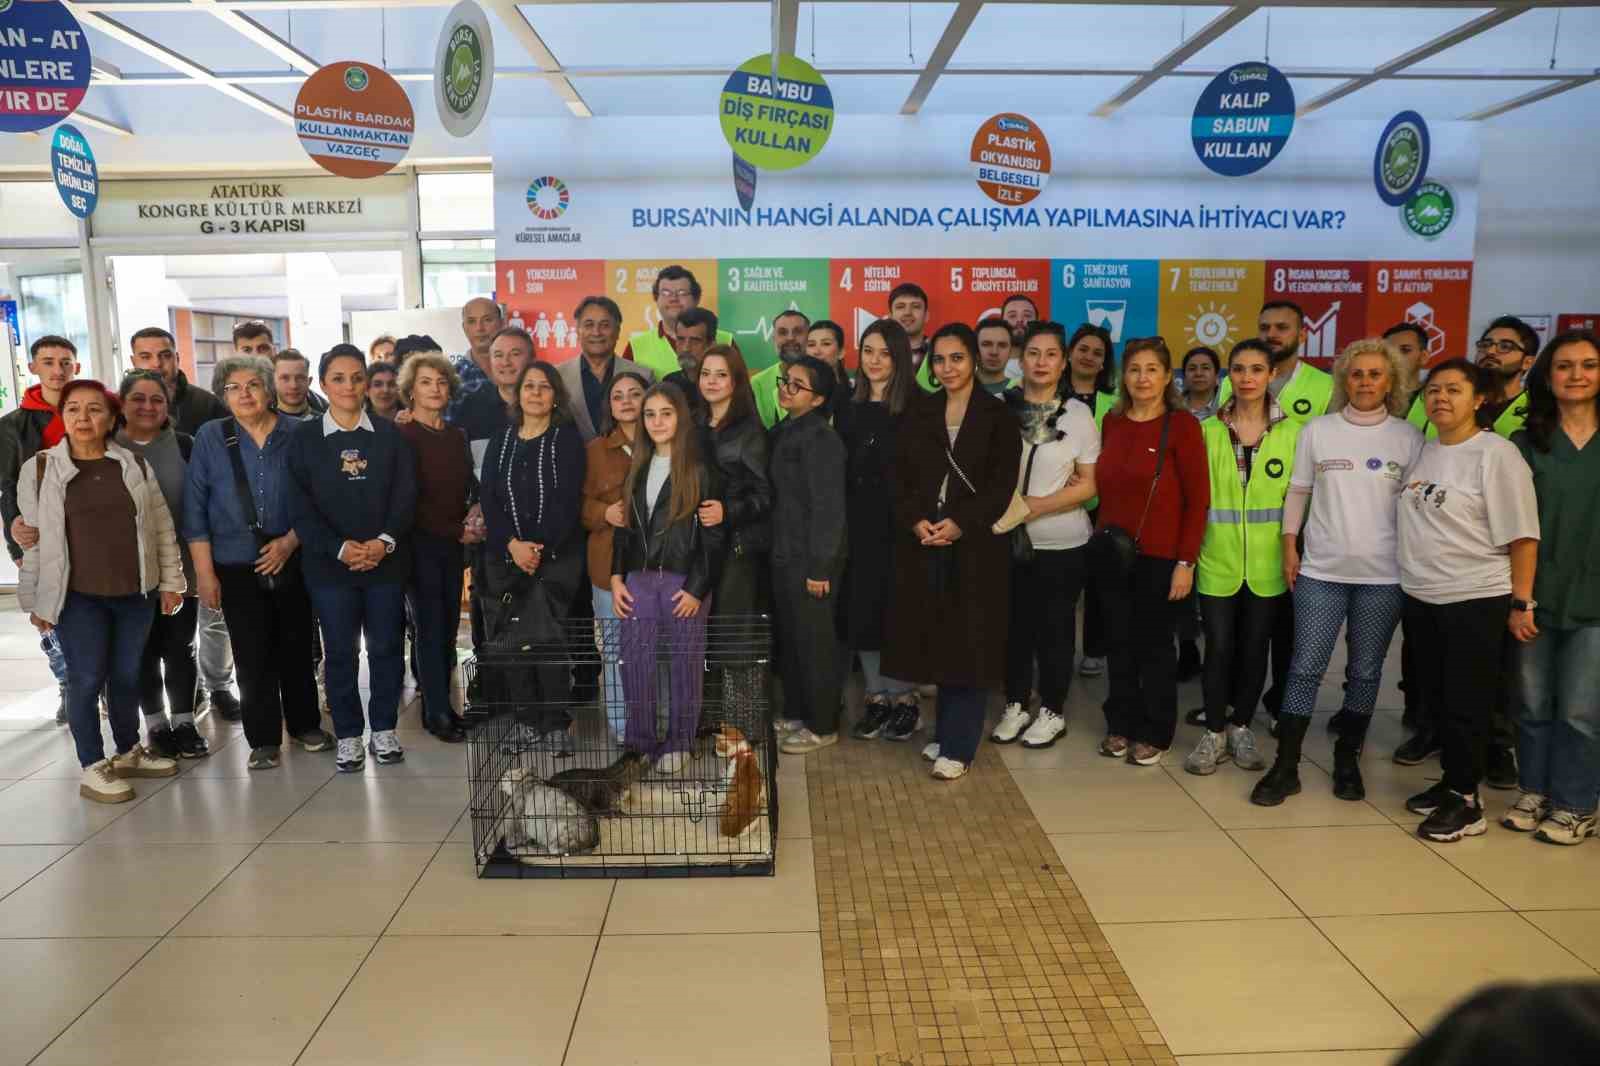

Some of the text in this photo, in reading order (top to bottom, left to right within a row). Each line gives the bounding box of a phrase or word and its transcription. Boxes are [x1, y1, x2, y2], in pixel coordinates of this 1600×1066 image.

[50, 30, 80, 50] AT
[747, 76, 813, 101] BAMBU
[0, 89, 69, 112] IR DE
[1220, 91, 1271, 110] KALIP
[296, 104, 412, 128] PLASTİK BARDAK
[723, 97, 829, 131] DİŞ FIRÇASI
[1213, 117, 1271, 134] SABUN
[299, 121, 409, 144] KULLANMAKTAN
[735, 127, 811, 153] KULLAN
[988, 133, 1037, 152] PLASTİK
[59, 134, 87, 156] DOĞAL
[327, 142, 381, 160] VAZGEÇ
[1203, 142, 1272, 158] KULLAN
[57, 152, 94, 176] TEMİZLİK
[980, 150, 1041, 170] OKYANUSU
[57, 167, 96, 195] ÜRÜNLERİ
[979, 168, 1041, 187] BELGESELİ
[210, 183, 283, 199] ATATÜRK
[997, 185, 1024, 202] İZLE
[71, 194, 87, 212] SEÇ
[138, 198, 363, 219] KONGRE KÜLTÜR MERKEZİ
[200, 221, 214, 234] G
[230, 221, 241, 233] 3
[245, 219, 305, 233] KAPISI
[632, 202, 1346, 231] BURSA'NIN HANGİ ALANDA ÇALIŞMA YAPILMASINA İHTİYACI VAR?
[505, 268, 516, 295] 1
[616, 268, 628, 294] 2
[727, 266, 740, 292] 3
[839, 266, 854, 292] 4
[951, 266, 964, 292] 5
[1063, 263, 1076, 289] 6
[1168, 266, 1181, 293] 7
[1273, 267, 1286, 293] 8
[1376, 268, 1389, 293] 9
